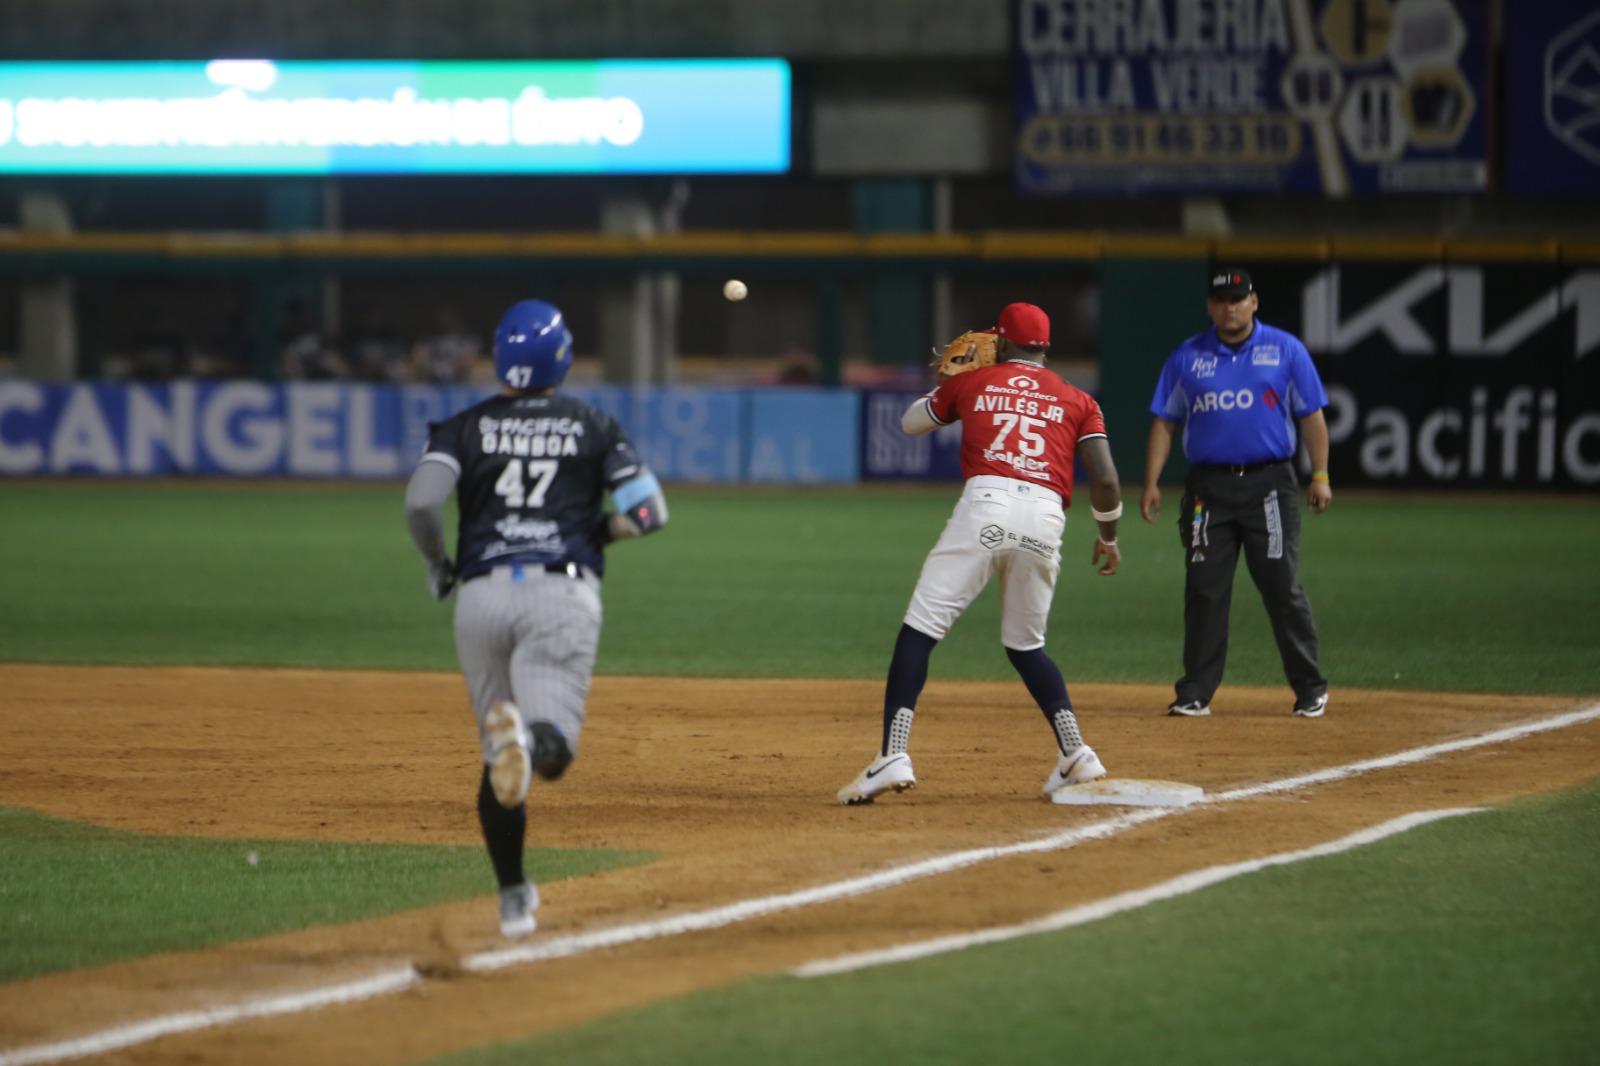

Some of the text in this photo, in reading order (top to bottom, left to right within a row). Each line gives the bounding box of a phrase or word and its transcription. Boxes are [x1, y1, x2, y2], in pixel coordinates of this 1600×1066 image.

[1029, 59, 1263, 110] VILLA VERDE
[506, 365, 533, 388] 47
[985, 385, 1058, 402] Banco Azteca
[1193, 389, 1253, 413] ARCO
[973, 395, 1064, 423] AVILÉS JR
[501, 417, 584, 437] PACIFICA
[990, 413, 1046, 457] 75
[481, 432, 578, 457] GAMBOA
[494, 458, 559, 508] 47
[1008, 532, 1017, 541] EL
